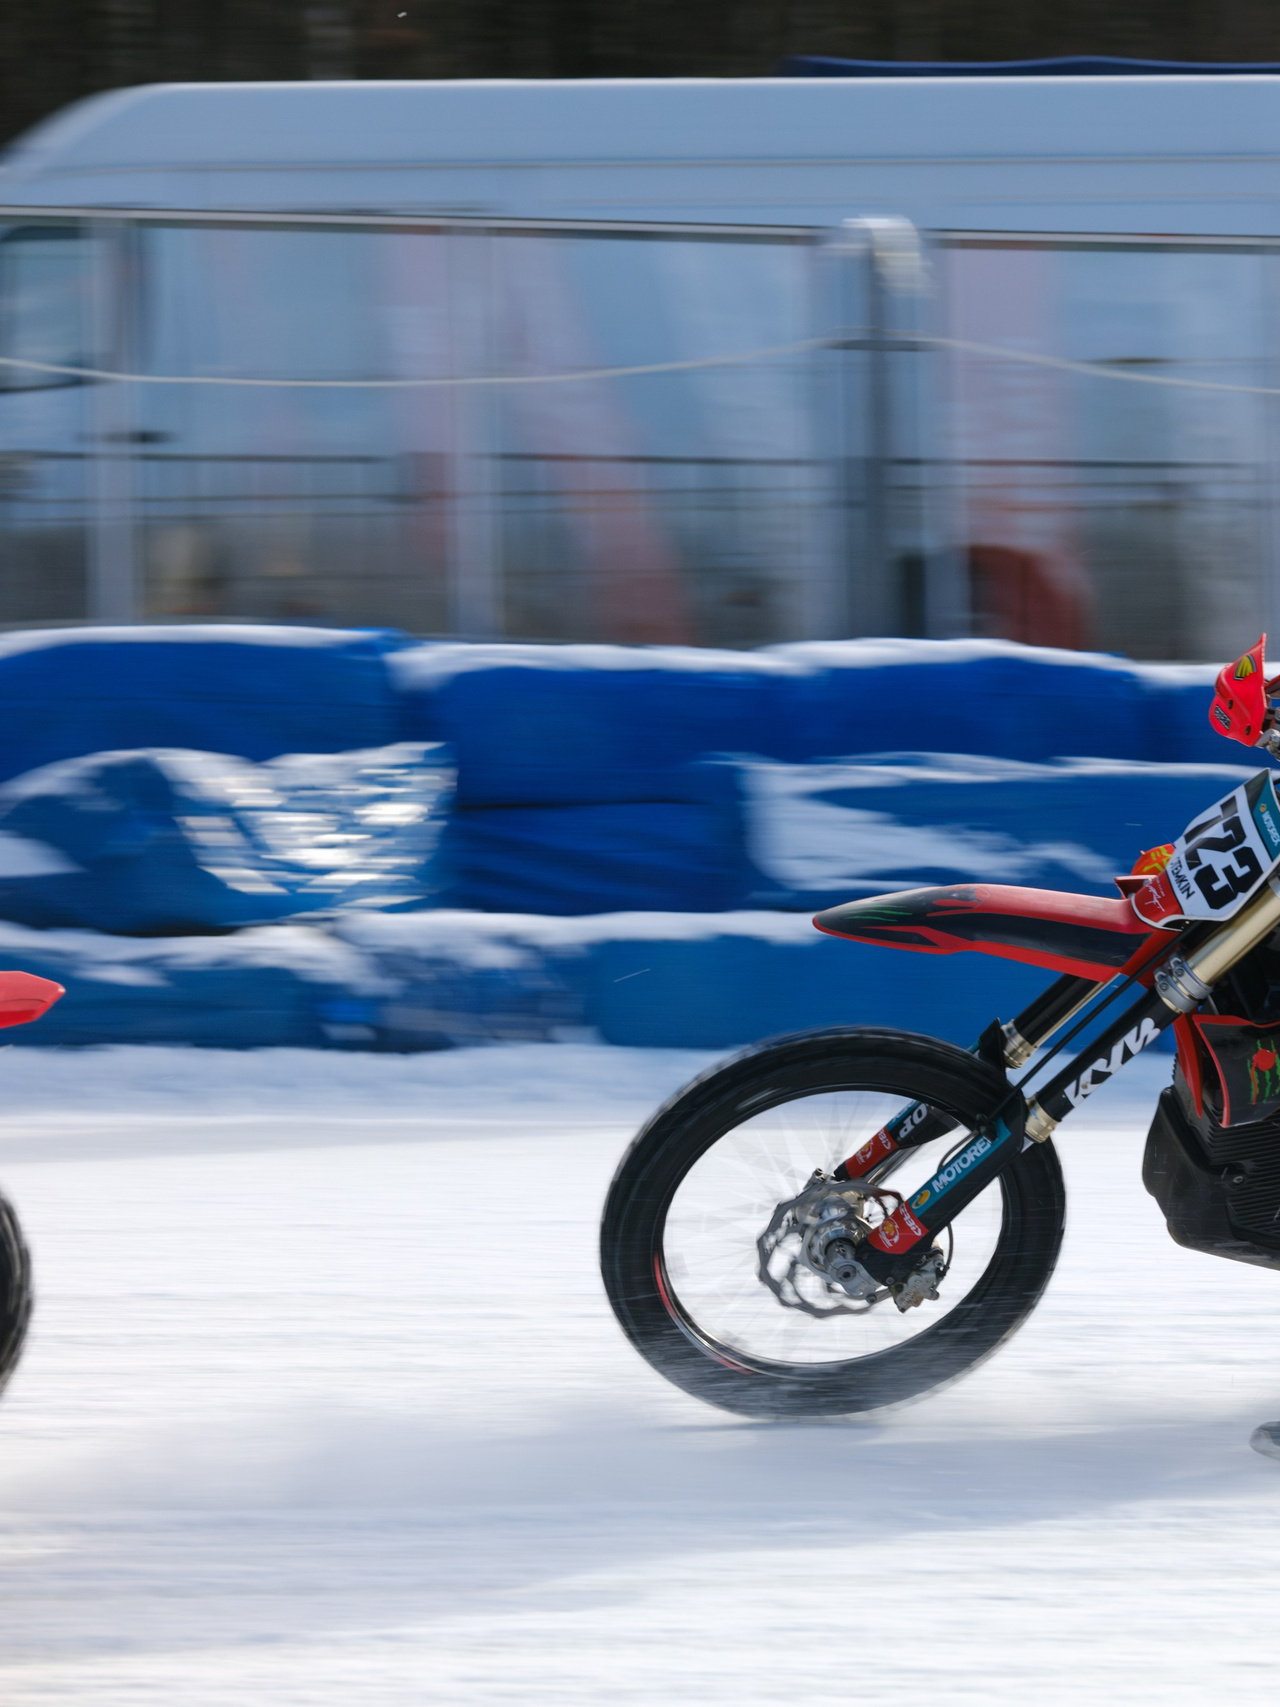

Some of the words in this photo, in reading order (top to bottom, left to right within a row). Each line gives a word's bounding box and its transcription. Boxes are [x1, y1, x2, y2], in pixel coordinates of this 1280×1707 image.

[1183, 795, 1264, 910] 723
[1063, 1017, 1161, 1108] KYB
[931, 1136, 992, 1193] MOTORE
